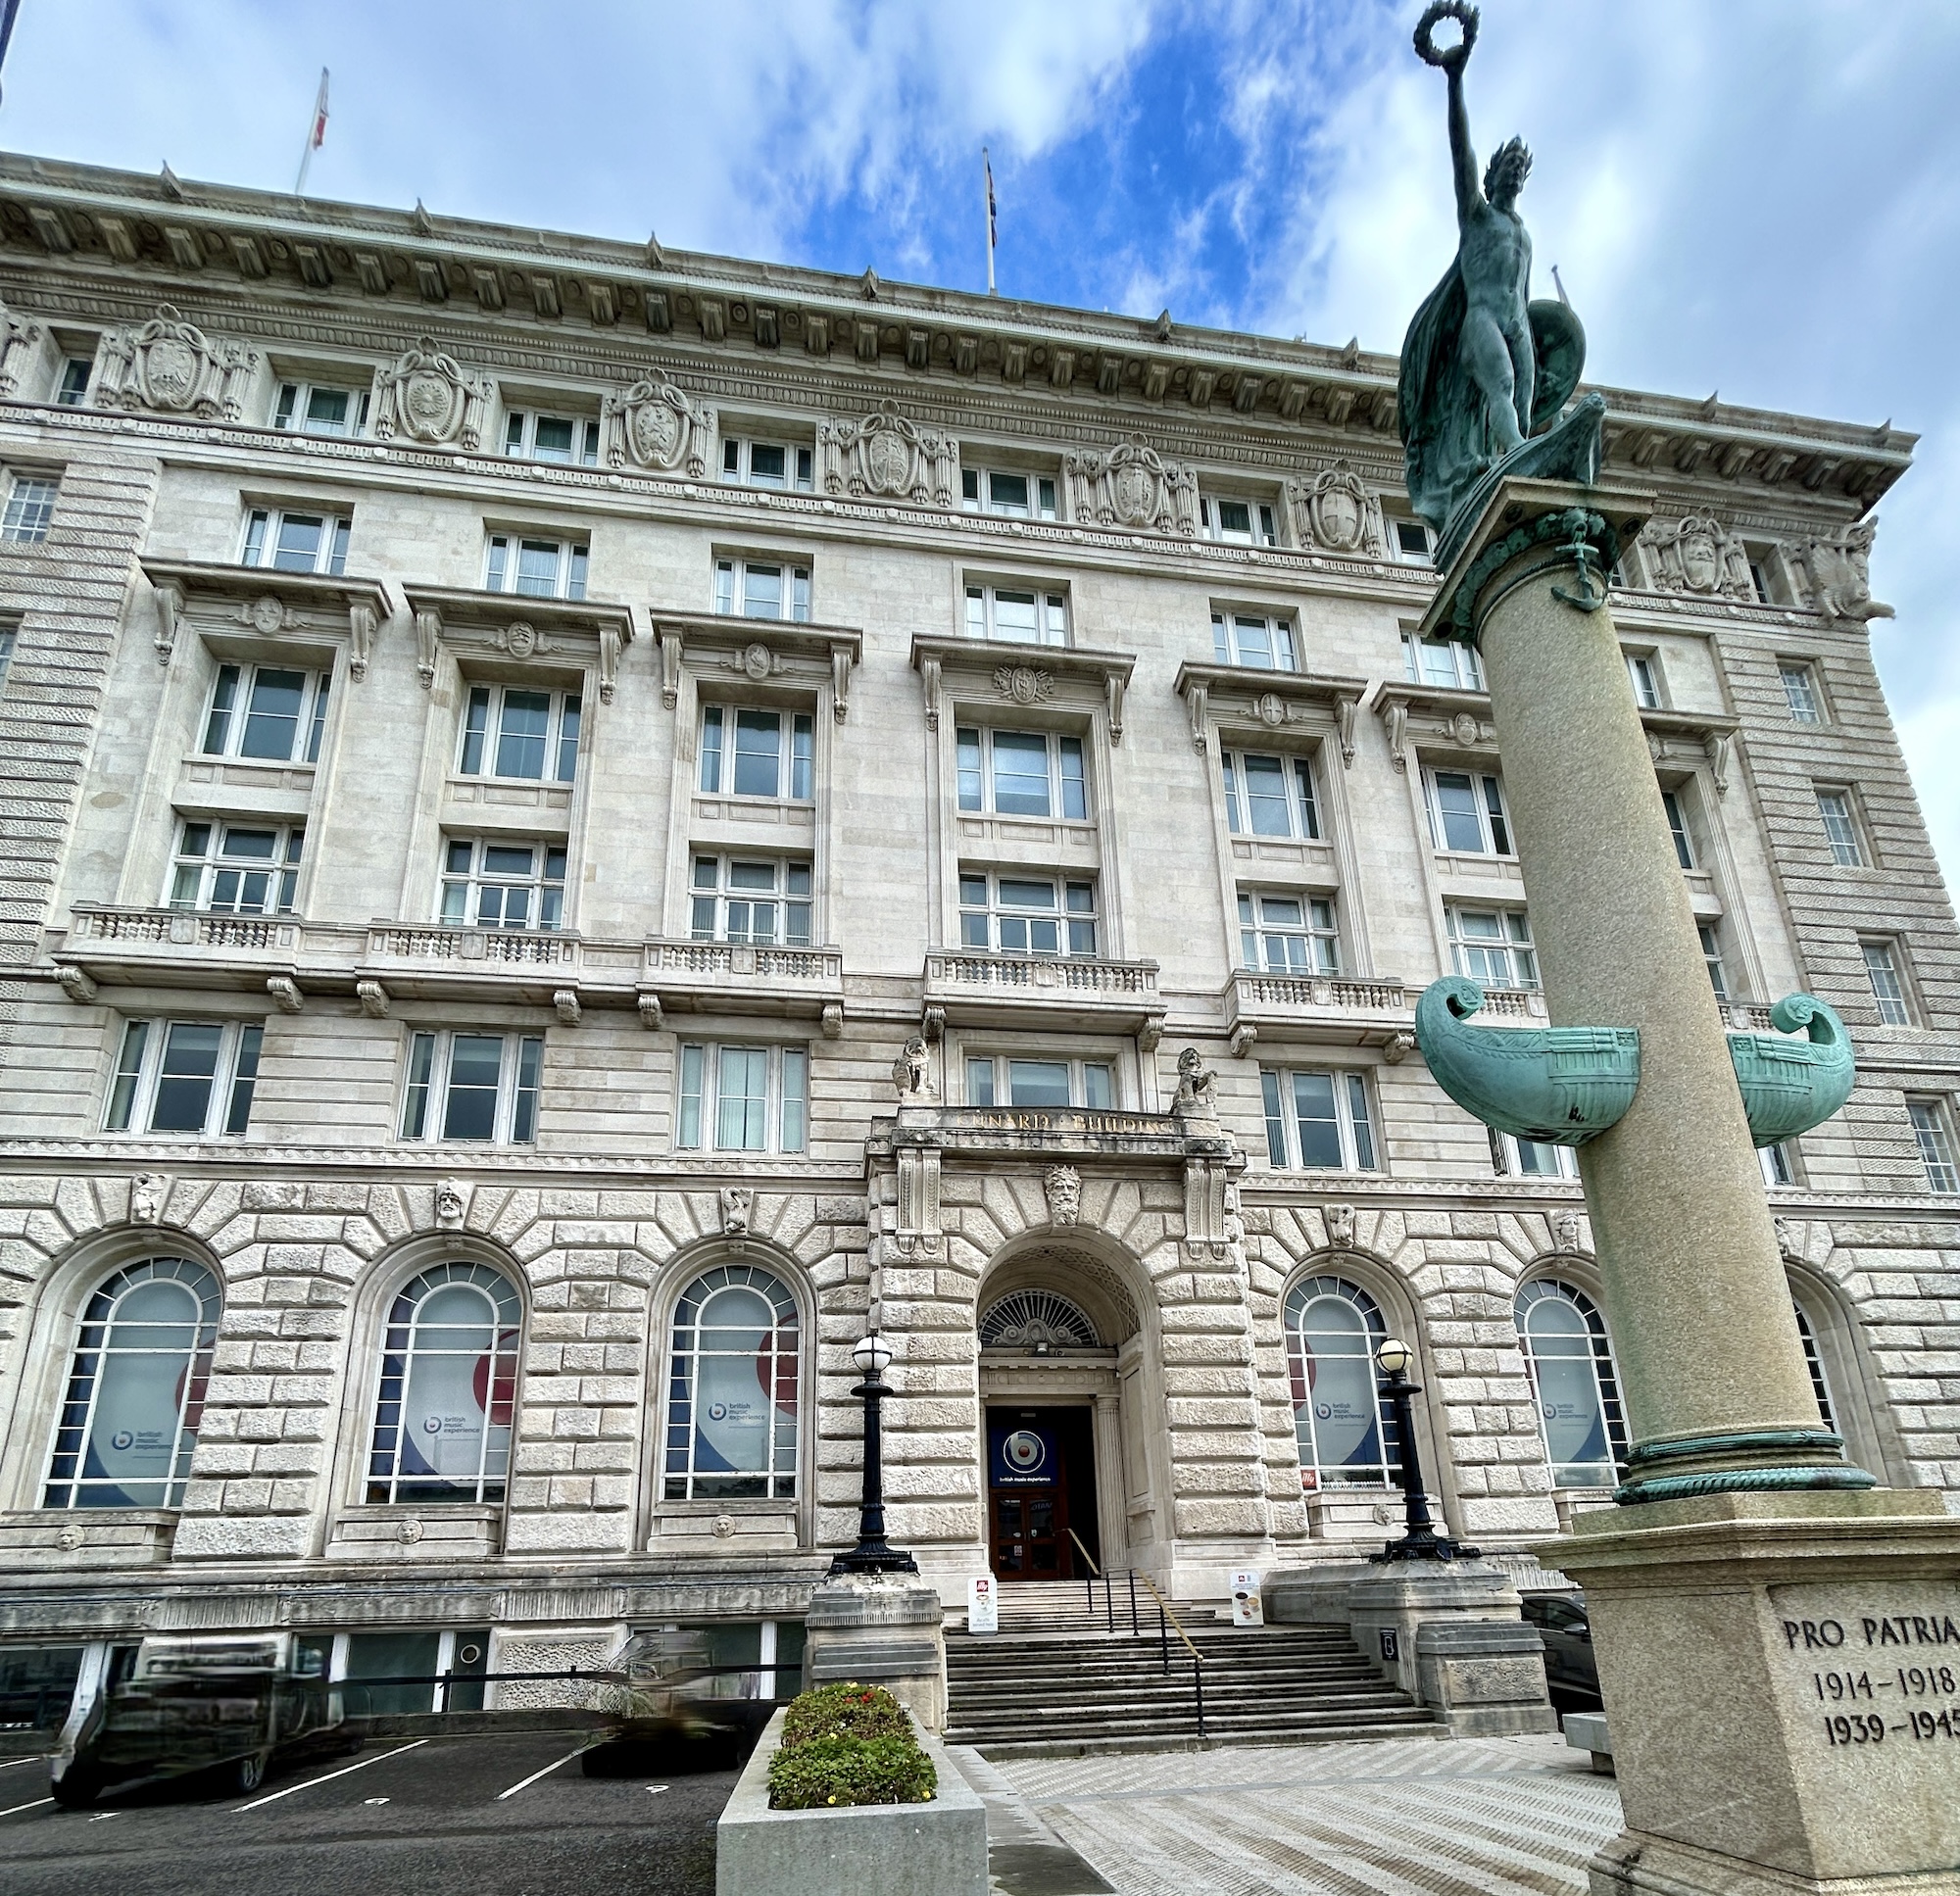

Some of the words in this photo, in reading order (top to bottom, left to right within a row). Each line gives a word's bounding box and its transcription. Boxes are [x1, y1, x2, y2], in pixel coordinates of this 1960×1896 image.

[956, 1113, 1051, 1130] CUNARD
[1072, 1114, 1174, 1135] BUILDING
[1784, 1619, 1844, 1650] PRO
[1862, 1616, 1960, 1646] PATRIA
